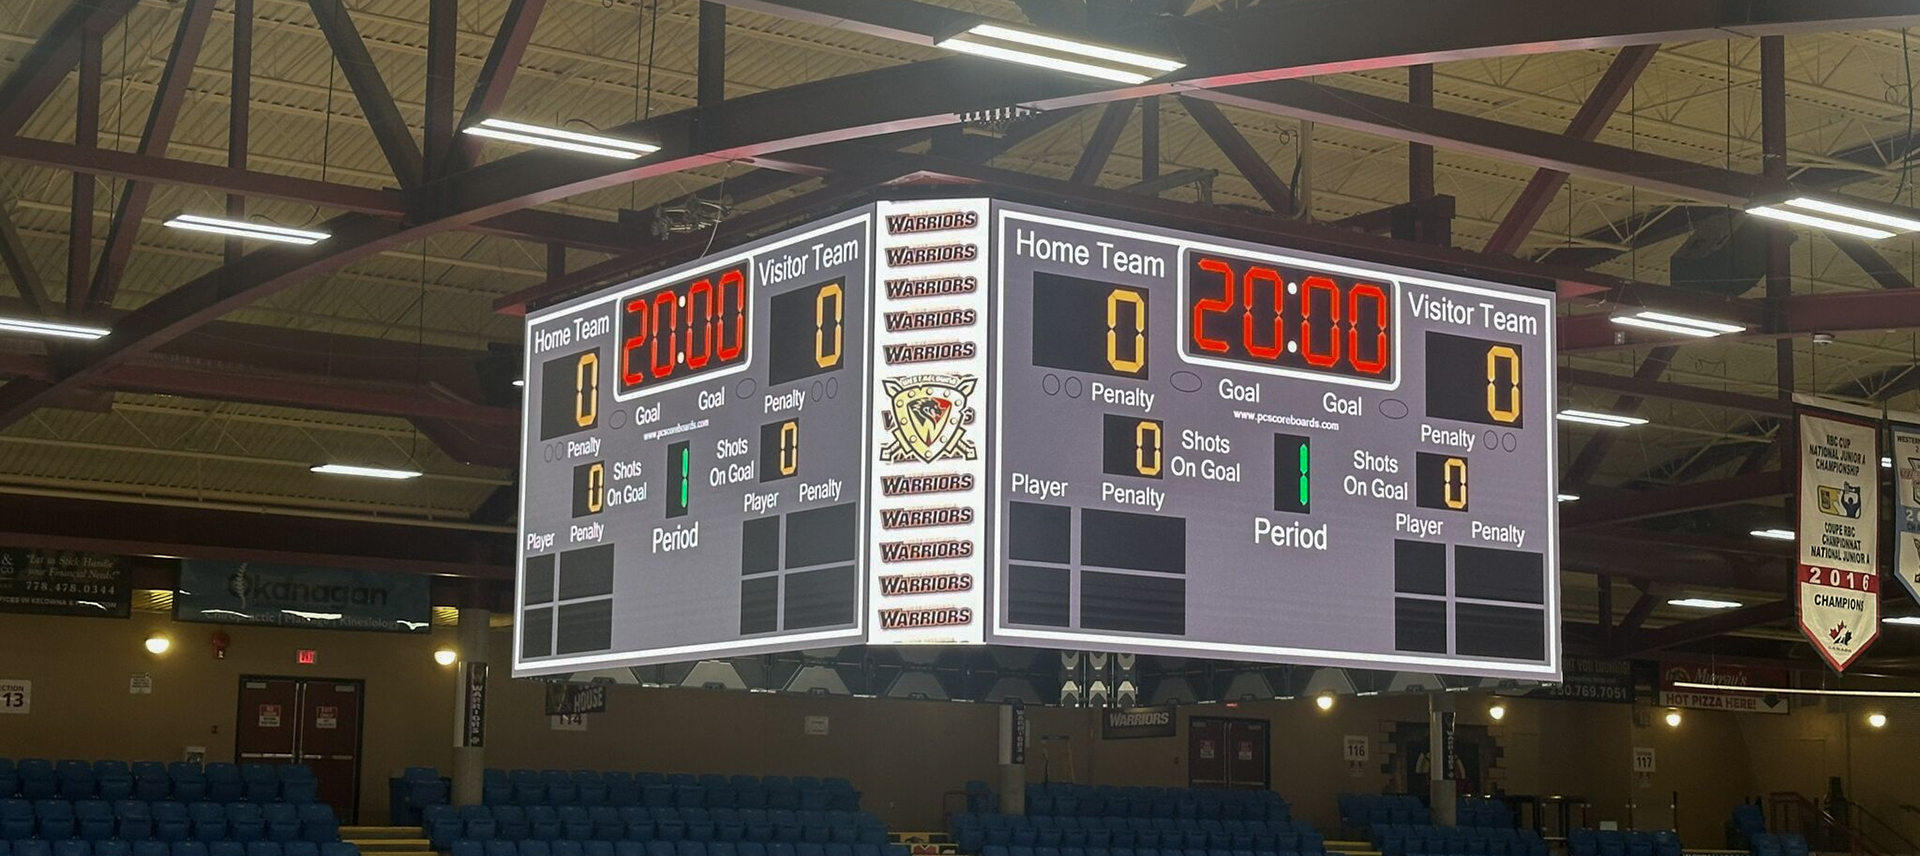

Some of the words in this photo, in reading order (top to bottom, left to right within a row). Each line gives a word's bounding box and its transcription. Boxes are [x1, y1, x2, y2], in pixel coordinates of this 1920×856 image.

[885, 210, 978, 235] WARRIORS
[759, 255, 808, 287] Visitor
[812, 239, 859, 269] Team
[884, 243, 978, 268] WARRIORS
[1016, 228, 1090, 267] Home
[1097, 241, 1165, 278] Team
[884, 276, 977, 300] WARRIORS
[815, 283, 843, 369] 0
[884, 309, 976, 332] WARRIORS
[1193, 258, 1386, 374] 20:00
[1407, 291, 1475, 325] Visitor
[1479, 302, 1537, 336] Team
[534, 327, 571, 354] Home
[573, 314, 610, 342] Team
[622, 269, 744, 387] 20:00
[1107, 288, 1145, 373] 0
[882, 341, 976, 365] WARRIORS
[575, 352, 599, 427] 0
[1091, 381, 1155, 412] Penalty
[1218, 378, 1260, 403] Goal
[1487, 345, 1520, 423] 0
[698, 386, 725, 410] Goal
[764, 388, 806, 413] Penalty
[1323, 392, 1362, 417] Goal
[635, 402, 661, 426] Goal
[1233, 408, 1339, 433] www.pcscoreboards.com
[568, 437, 601, 459] Penalty
[717, 437, 748, 459] Shots
[780, 421, 797, 475] 0
[1136, 421, 1161, 476] 0
[1181, 429, 1230, 454] Shots
[1421, 424, 1475, 451] Penalty
[1839, 437, 1851, 449] CUP
[1353, 450, 1398, 473] Shots
[1809, 444, 1839, 460] NATIONAL
[1840, 451, 1861, 463] JUNIOR
[1862, 454, 1866, 465] A
[613, 460, 642, 480] Shots
[681, 447, 688, 508] 1
[710, 466, 726, 487] On
[728, 461, 755, 485] Goal
[1171, 456, 1197, 477] On
[1201, 459, 1240, 483] Goal
[1300, 443, 1308, 506] 1
[1816, 458, 1860, 477] CHAMPIONSHIP
[588, 463, 604, 513] 0
[607, 487, 623, 507] On
[623, 482, 647, 504] Goal
[799, 478, 842, 502] Penalty
[880, 473, 974, 496] WARRIORS
[1011, 472, 1068, 500] Player
[1343, 475, 1367, 497] On
[1371, 477, 1408, 501] Goal
[1444, 458, 1466, 509] 0
[744, 490, 779, 514] Player
[1102, 482, 1165, 512] Penalty
[880, 506, 974, 530] WARRIORS
[1396, 513, 1443, 536] Player
[1824, 522, 1843, 536] COUPE
[1844, 526, 1855, 537] RBC
[527, 529, 555, 553] Player
[570, 522, 605, 543] Penalty
[652, 522, 699, 553] Period
[1254, 517, 1328, 550] Period
[1471, 521, 1525, 548] Penalty
[1822, 534, 1861, 551] CHAMPIONNAT
[1, 553, 13, 566] &
[879, 540, 973, 563] WARRIORS
[1811, 546, 1842, 561] NATIONAL
[1843, 552, 1865, 564] JUNIOR
[26, 581, 116, 596] 778.478.0344
[878, 573, 972, 596] WARRIORS
[1814, 594, 1864, 613] CHAMPIONS
[878, 607, 972, 630] WARRIORS
[574, 686, 604, 713] HOUSE
[1666, 694, 1690, 706] HOT
[1692, 695, 1722, 708] PIZZA
[1725, 697, 1756, 710] HERE!
[1109, 712, 1170, 727] WARRIORS
[1348, 745, 1365, 757] 116
[1637, 756, 1651, 768] 117
